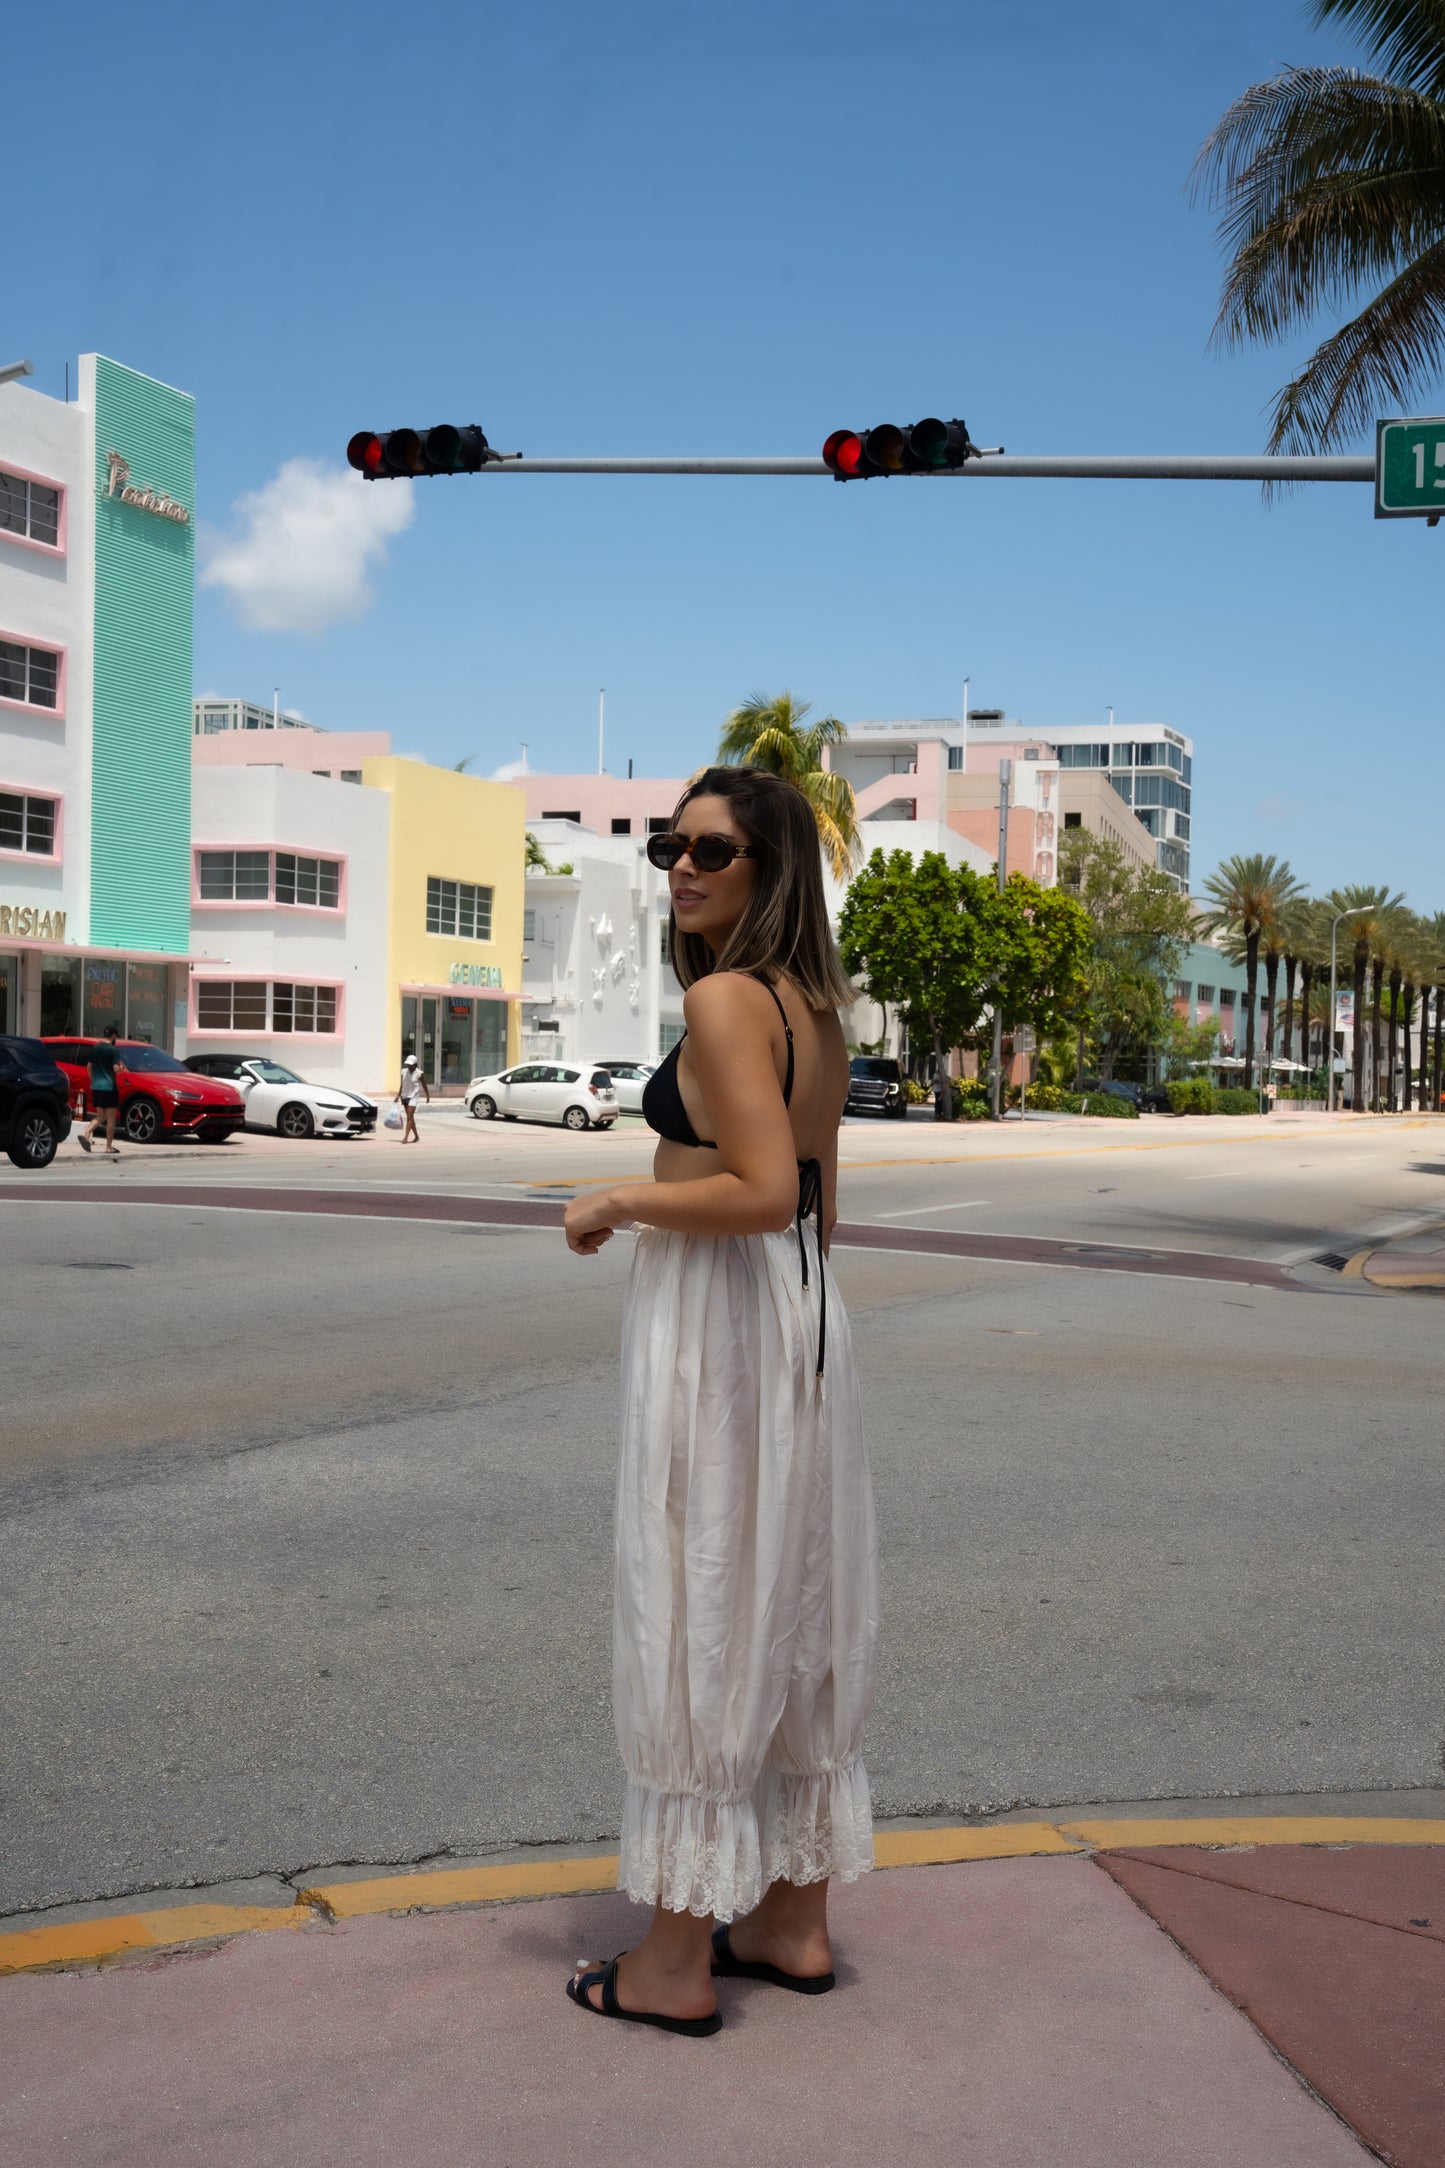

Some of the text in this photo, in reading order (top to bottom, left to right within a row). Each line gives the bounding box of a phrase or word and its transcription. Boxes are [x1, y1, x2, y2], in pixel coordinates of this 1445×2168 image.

[0, 904, 66, 938] RISIAN
[87, 967, 118, 982] EXOTIC
[448, 962, 503, 988] GENEVA
[91, 981, 115, 995] CAR
